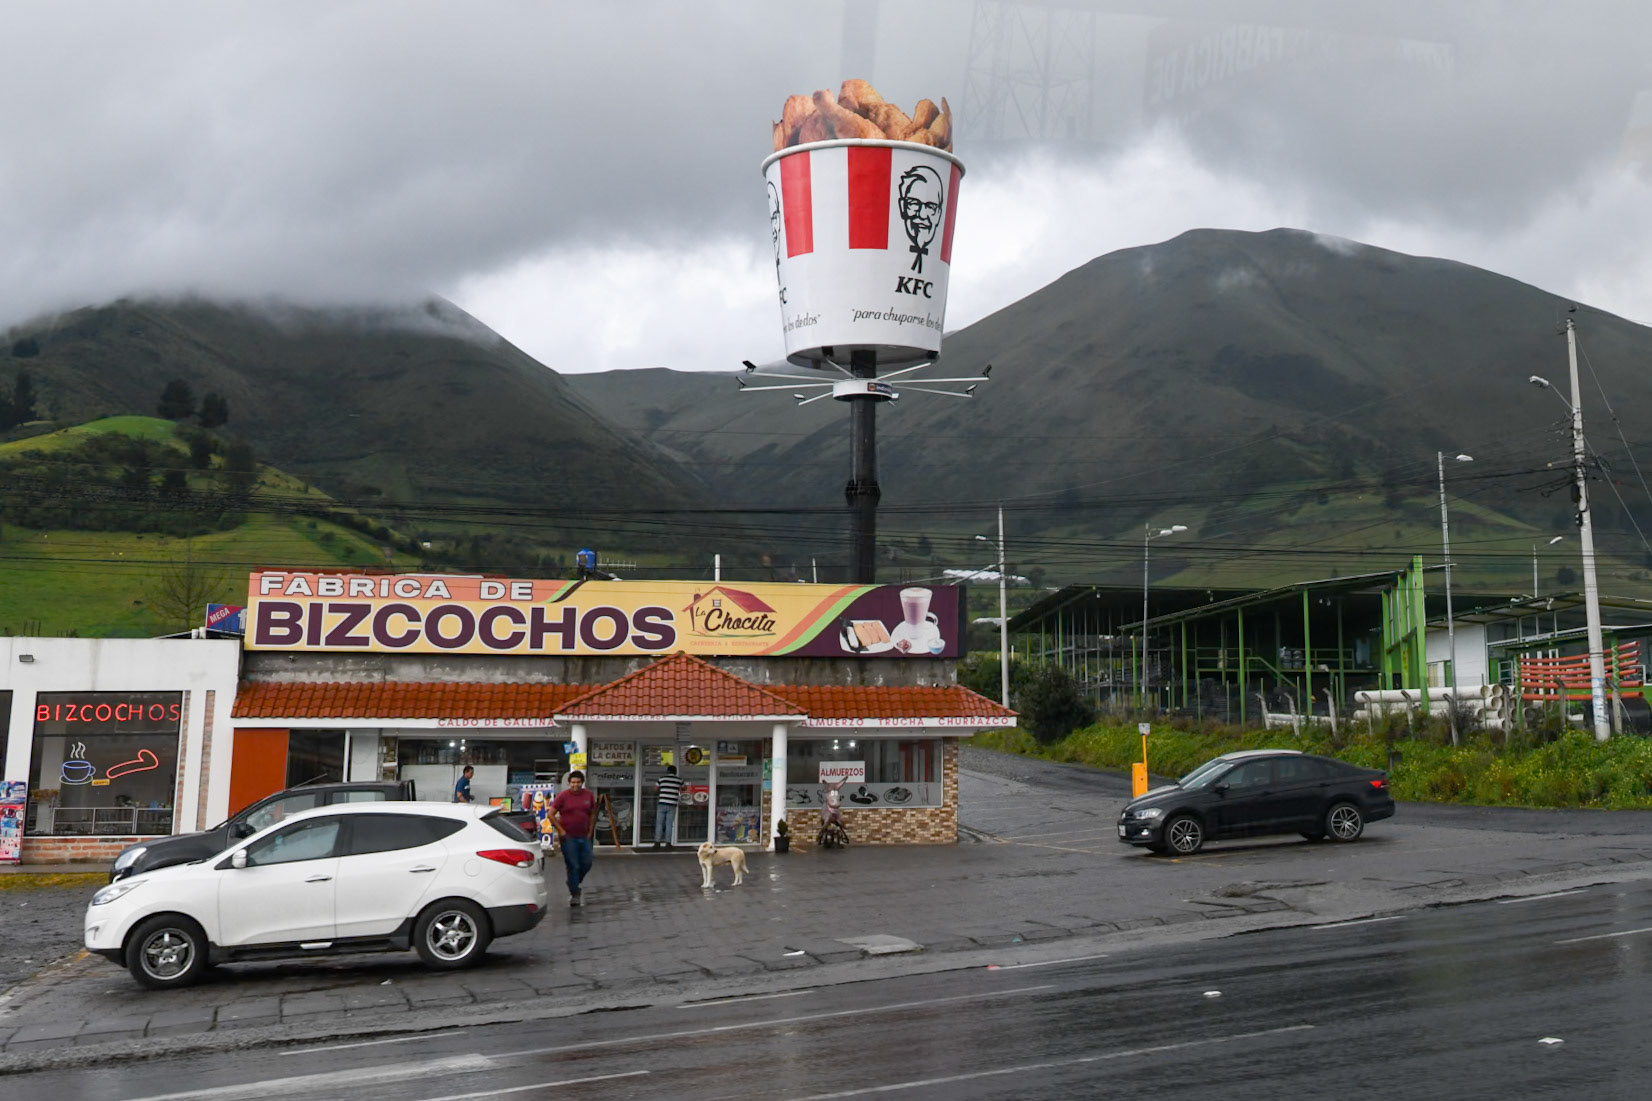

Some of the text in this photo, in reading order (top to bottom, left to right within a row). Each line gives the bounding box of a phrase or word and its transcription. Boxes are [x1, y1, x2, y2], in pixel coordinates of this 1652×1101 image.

[895, 276, 933, 299] KFC
[883, 306, 925, 326] chuparse
[260, 576, 533, 600] FABRICA DE
[209, 607, 231, 623] MEGA
[695, 606, 706, 617] La
[254, 601, 677, 651] BIZCOCHOS
[704, 608, 776, 632] Chocita
[36, 703, 181, 721] BIZCOCHOS
[438, 718, 555, 727] CALDO DE GALLINA
[801, 716, 1009, 727] ALMUERZO TRUCHA CHURRAZCO
[592, 743, 633, 751] PLATOS A
[592, 752, 604, 760] LA
[605, 752, 633, 760] CARTA
[820, 767, 864, 777] ALMUERZOS
